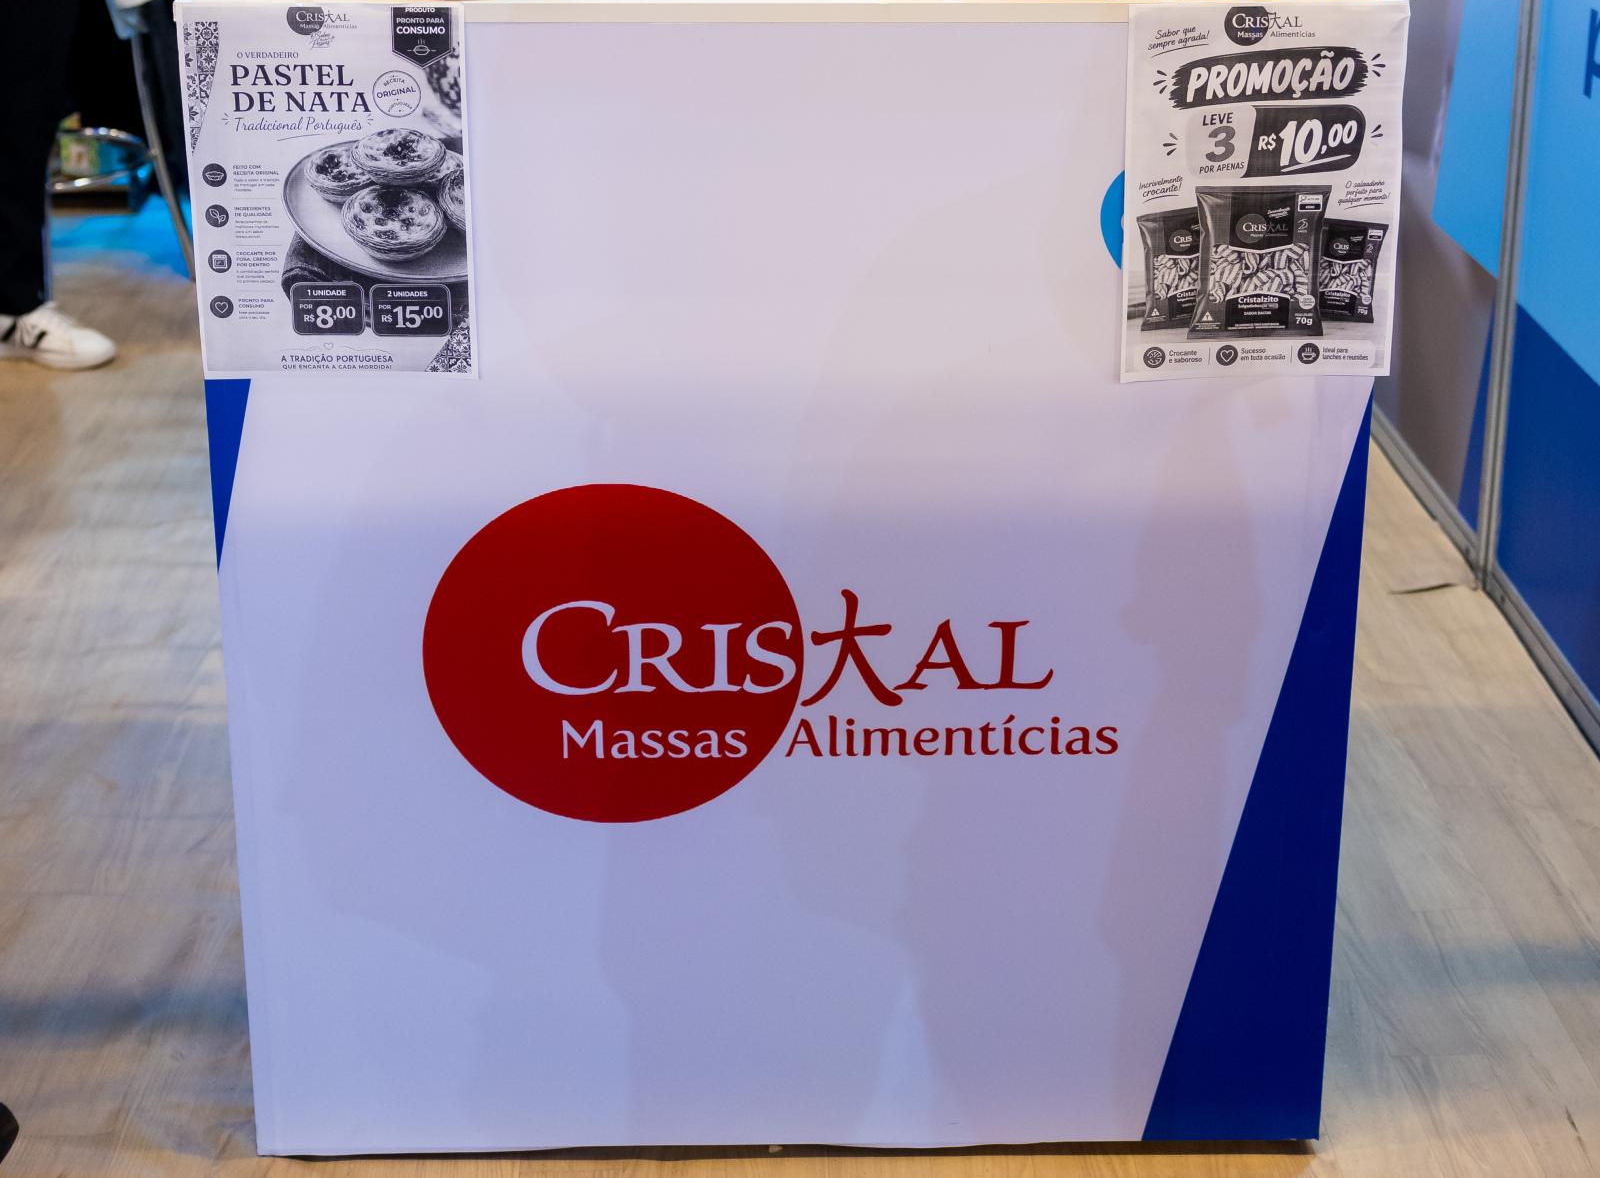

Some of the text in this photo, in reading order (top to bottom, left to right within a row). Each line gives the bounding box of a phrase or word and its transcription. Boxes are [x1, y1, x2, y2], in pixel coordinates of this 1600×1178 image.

[396, 26, 445, 34] CONSUMO
[1155, 26, 1197, 40] Sabor que
[1237, 30, 1316, 38] Massas Alimentícias
[1148, 30, 1210, 51] sempre agrada!
[245, 51, 299, 59] VERDADEIRO
[230, 64, 354, 87] PASTEL
[383, 78, 405, 87] RECEITA
[1186, 50, 1355, 102] PROMOÇÃO
[377, 86, 416, 99] ORIGINAL
[233, 91, 372, 113] DE NATA
[234, 116, 362, 134] Tradicional Português
[1202, 112, 1234, 126] LEVE
[1205, 126, 1236, 162] 3
[1258, 119, 1358, 164] R$ 10,00
[1199, 162, 1245, 174] POR APENAS
[1142, 182, 1182, 198] crocante!
[1238, 295, 1279, 303] Cristalzito
[304, 306, 356, 329] R$ 8,00
[382, 306, 443, 329] R$ 15,00
[1295, 316, 1313, 326] 70g
[290, 354, 334, 364] TRADIÇÃO
[336, 355, 394, 363] PORTUGUESA
[561, 714, 1119, 759] Massas Alimentícias
